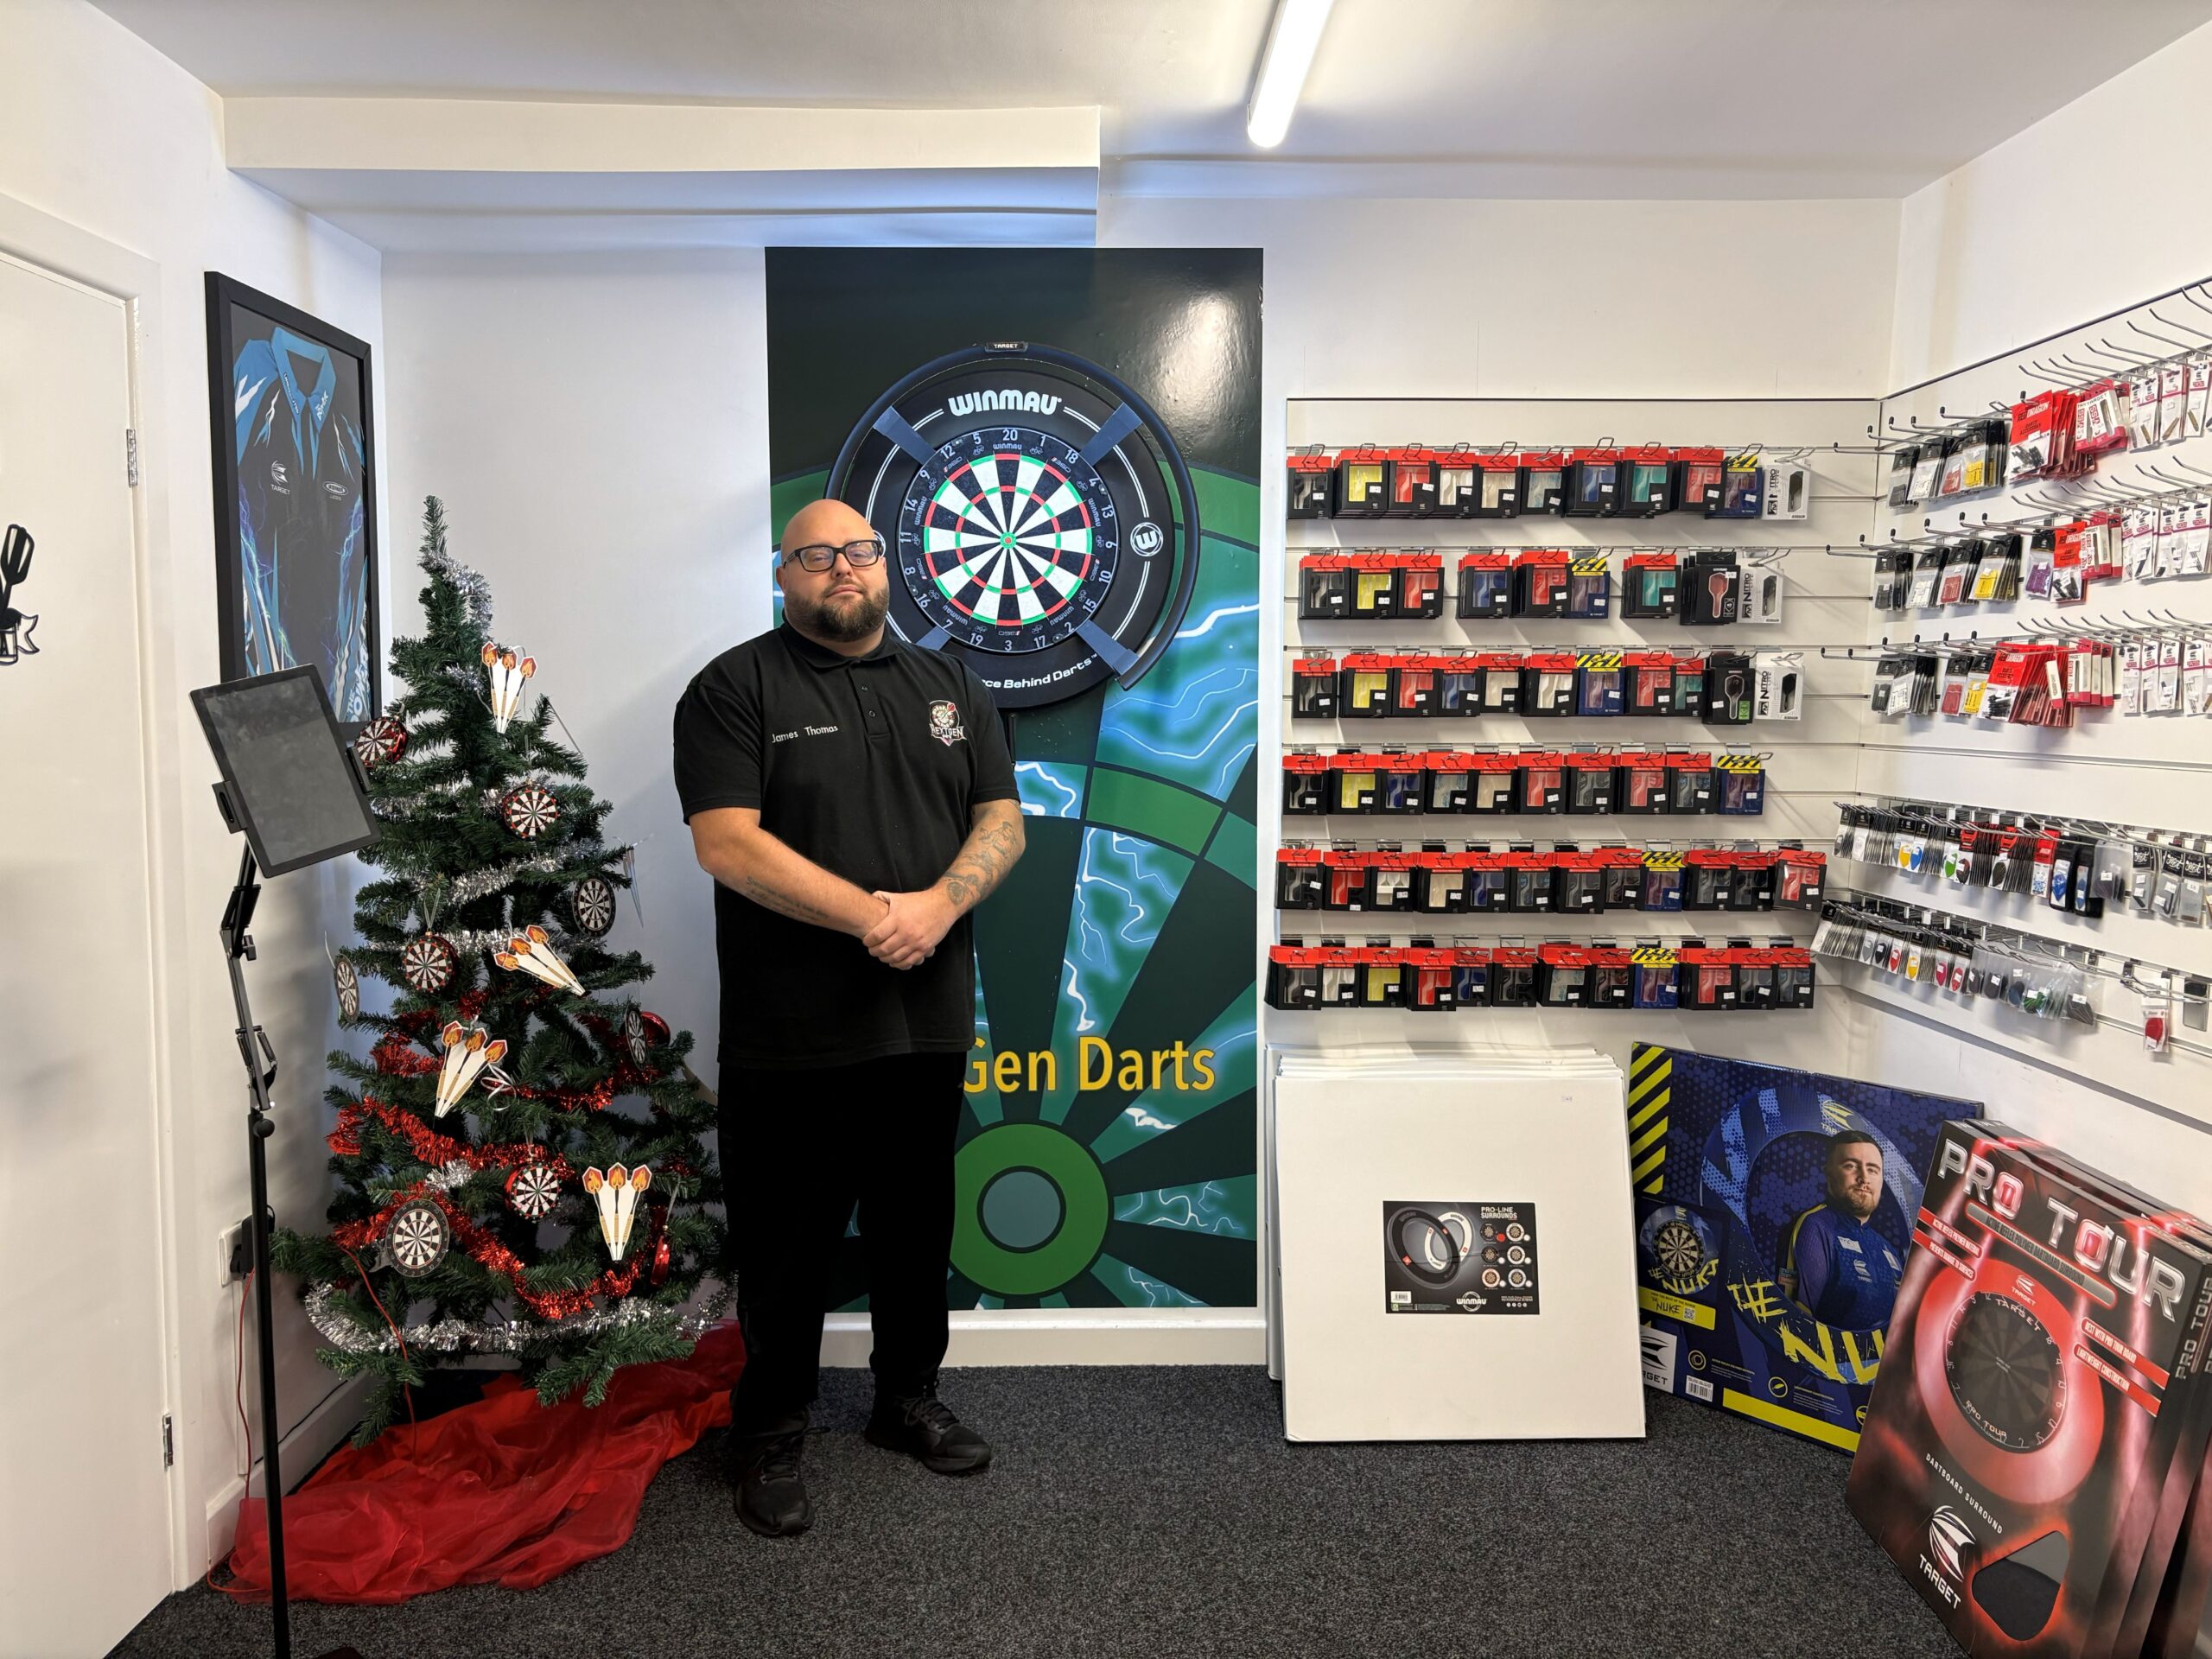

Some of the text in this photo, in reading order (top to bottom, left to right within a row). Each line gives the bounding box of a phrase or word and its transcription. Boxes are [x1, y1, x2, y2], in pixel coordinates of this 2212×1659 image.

[948, 390, 1061, 416] WINMAU
[972, 432, 981, 445] 5
[1002, 429, 1018, 441] 20
[1040, 435, 1046, 448] 1
[940, 445, 956, 460] 12
[1065, 448, 1079, 464] 18
[1089, 477, 1100, 487] 4
[905, 499, 918, 512] 14
[1101, 504, 1115, 518] 13
[899, 531, 912, 543] 11
[904, 566, 916, 575] 8
[1098, 569, 1112, 584] 10
[1743, 573, 1752, 602] NITRO
[916, 594, 931, 608] 16
[1083, 598, 1096, 613] 15
[943, 619, 953, 629] 7
[1064, 621, 1074, 632] 2
[969, 632, 983, 646] 19
[1004, 640, 1013, 651] 3
[1033, 634, 1046, 649] 17
[1003, 674, 1051, 689] Behind
[1760, 671, 1770, 699] NITRO
[772, 725, 838, 743] James Thomas
[1078, 1036, 1217, 1091] Darts
[1937, 1138, 2186, 1323] PRO TOUR
[2012, 1286, 2037, 1306] TARGET
[1656, 1300, 1681, 1315] NUKE
[1995, 1298, 2042, 1332] TARGET
[2175, 1339, 2197, 1380] PRO
[1925, 1452, 2003, 1535] DARTBOARD SURROUND
[1918, 1554, 1961, 1610] TARGET
